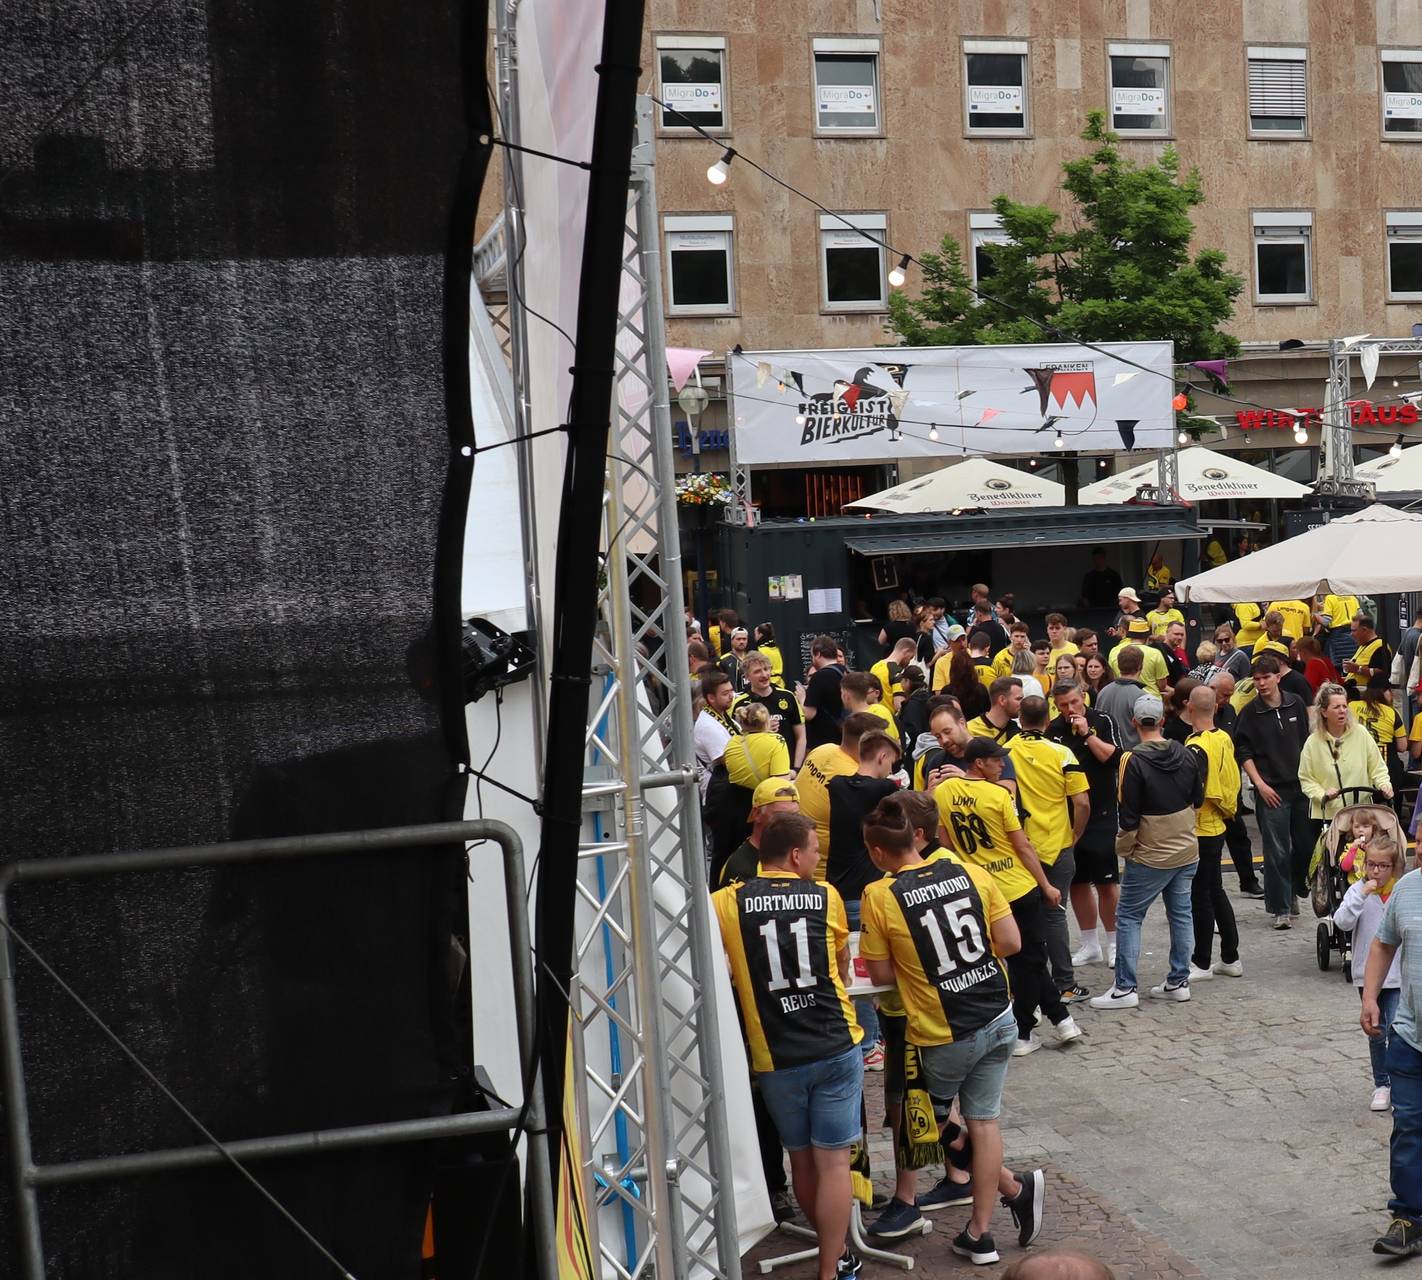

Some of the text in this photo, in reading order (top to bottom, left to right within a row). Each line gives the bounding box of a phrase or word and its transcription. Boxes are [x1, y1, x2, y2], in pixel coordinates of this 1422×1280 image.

[668, 86, 709, 98] MigraDo
[822, 89, 862, 100] MigraDo
[973, 90, 1012, 101] MigraDo
[1117, 92, 1154, 102] MigraDo
[1388, 97, 1422, 107] MigraDo
[1235, 404, 1419, 430] WIRTAUS
[801, 414, 885, 446] BIERKULTUR
[950, 811, 995, 855] 69
[981, 857, 1013, 873] MUND
[903, 875, 970, 908] DORTMUND
[744, 893, 823, 914] DORTMUND
[921, 896, 986, 976] 15
[759, 917, 818, 992] 11
[939, 960, 998, 994] HUMMELS
[780, 993, 817, 1014] REUS
